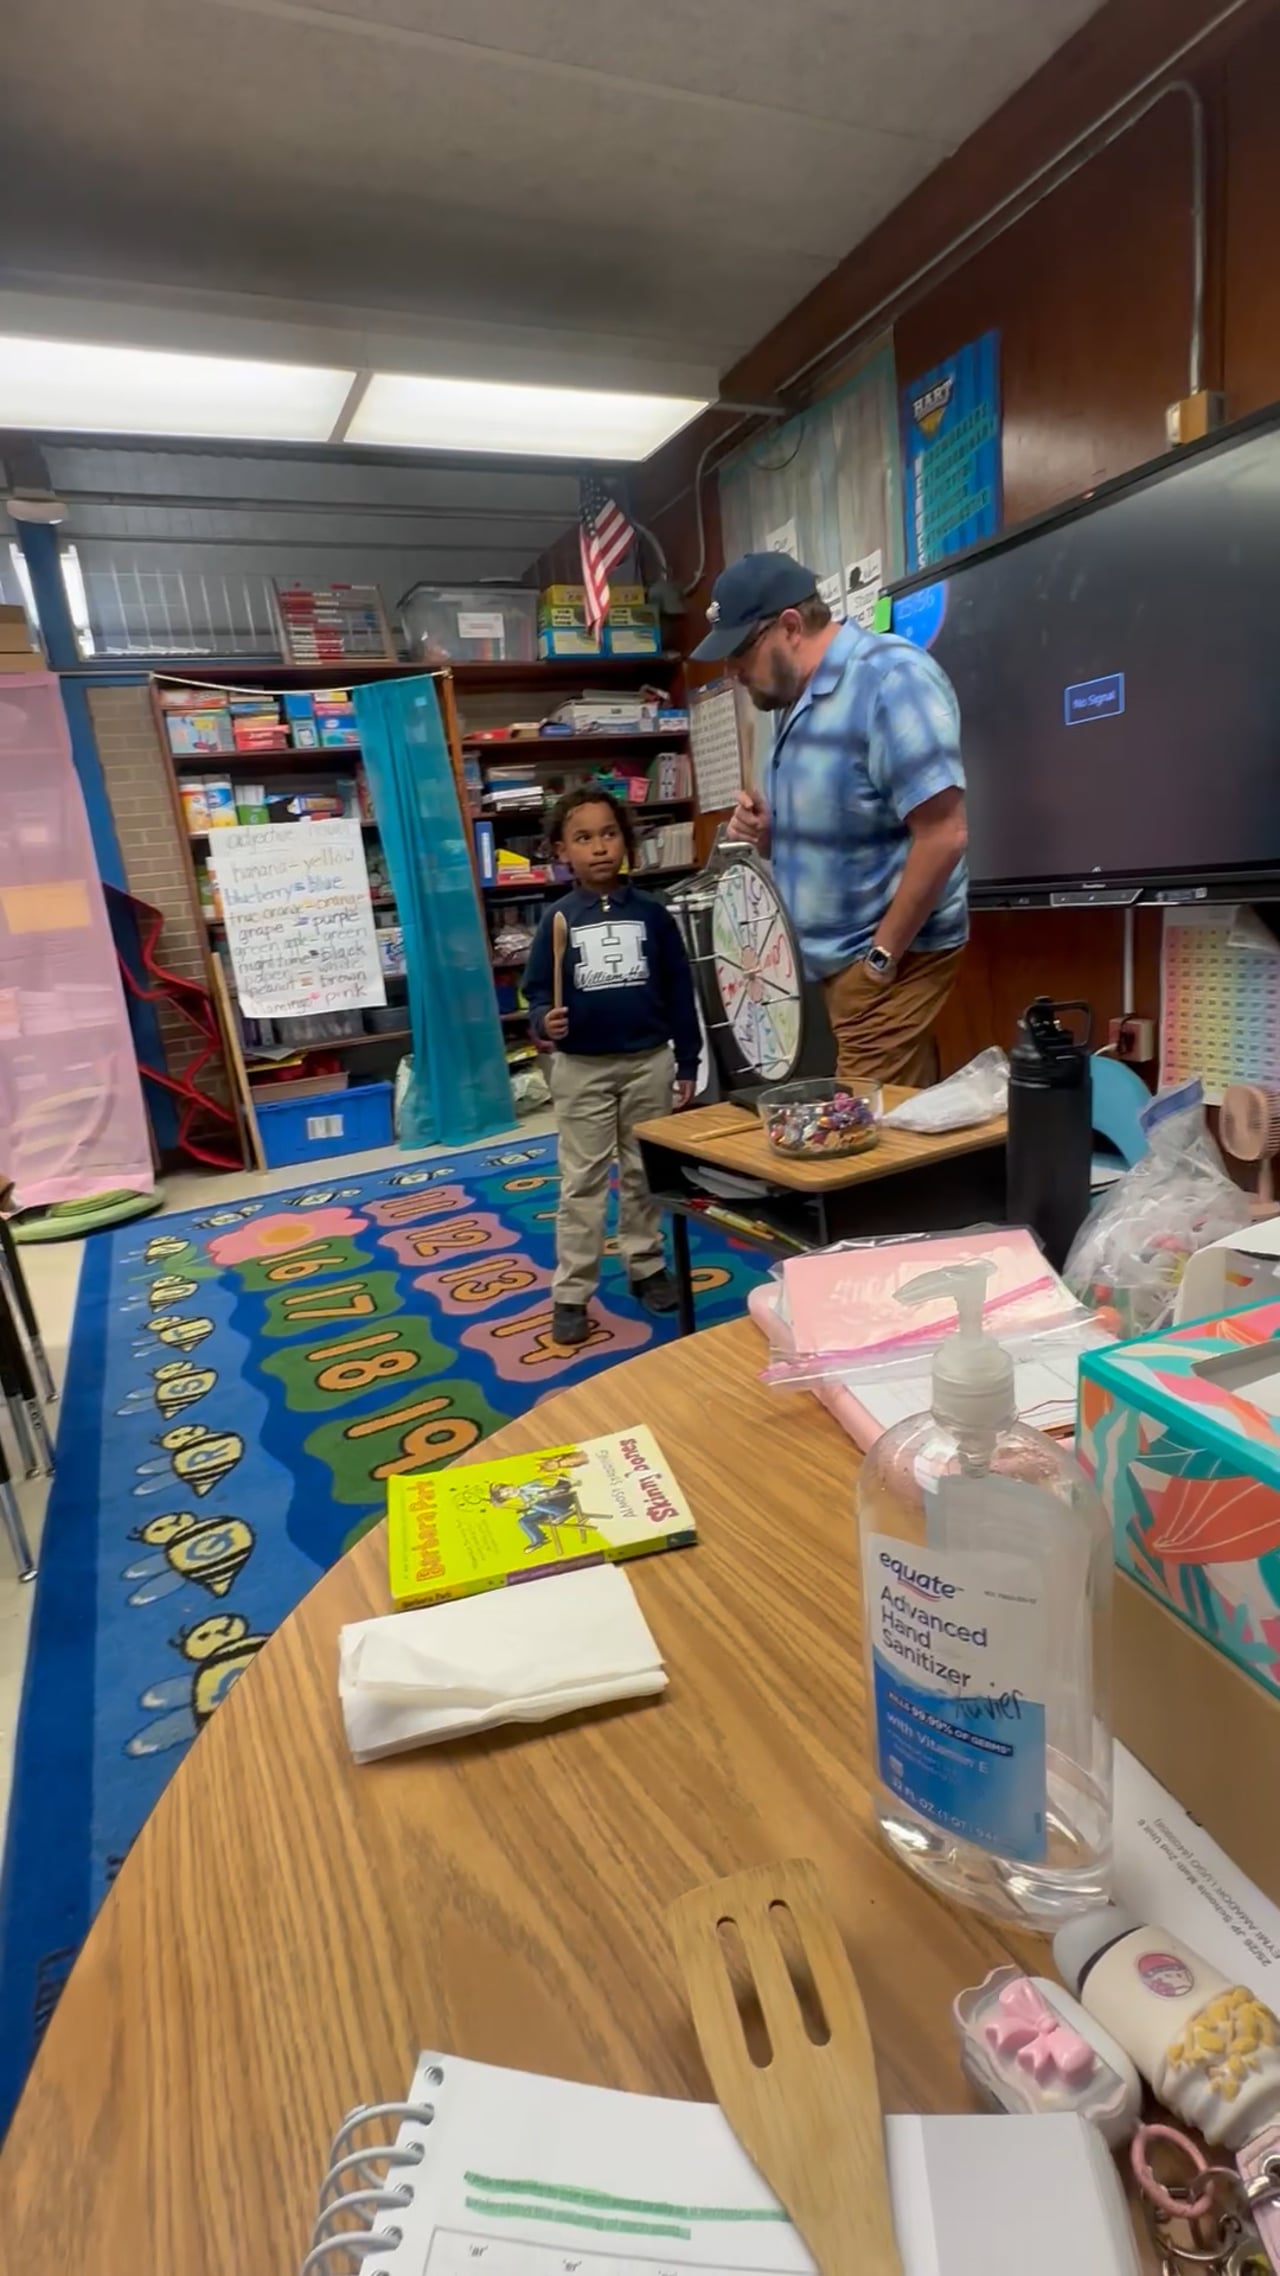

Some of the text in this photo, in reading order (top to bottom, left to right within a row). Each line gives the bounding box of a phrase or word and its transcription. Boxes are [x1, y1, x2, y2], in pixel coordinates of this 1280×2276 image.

[912, 376, 952, 422] HART
[1072, 690, 1116, 709] No Signal
[304, 849, 354, 872] yellow
[239, 910, 360, 945] grape purple
[325, 983, 367, 1006] pink
[381, 1191, 456, 1219] 11
[406, 1219, 492, 1257] 12
[257, 1243, 348, 1281] 16
[438, 1258, 538, 1304] 13
[283, 1282, 377, 1322] 17
[305, 1329, 422, 1393] 18
[343, 1395, 483, 1482] 19
[611, 1488, 638, 1518] ALMOST
[409, 1511, 446, 1583] Barbara
[879, 1552, 956, 1599] equate
[880, 1585, 988, 1647] Advanced
[881, 1604, 931, 1649] Hand
[882, 1628, 971, 1687] Sanitizer
[886, 1711, 914, 1738] with
[916, 1731, 974, 1768] Vitamin
[978, 1761, 989, 1774] E
[911, 1706, 953, 1735] 99.99%
[955, 1729, 970, 1741] OF
[1144, 1825, 1162, 1845] Unit
[1160, 1843, 1178, 1862] 2nd
[1176, 1861, 1198, 1885] Math
[1197, 1884, 1232, 1923] Schools
[1231, 1924, 1247, 1937] JP
[1244, 1938, 1272, 1967] 25/26
